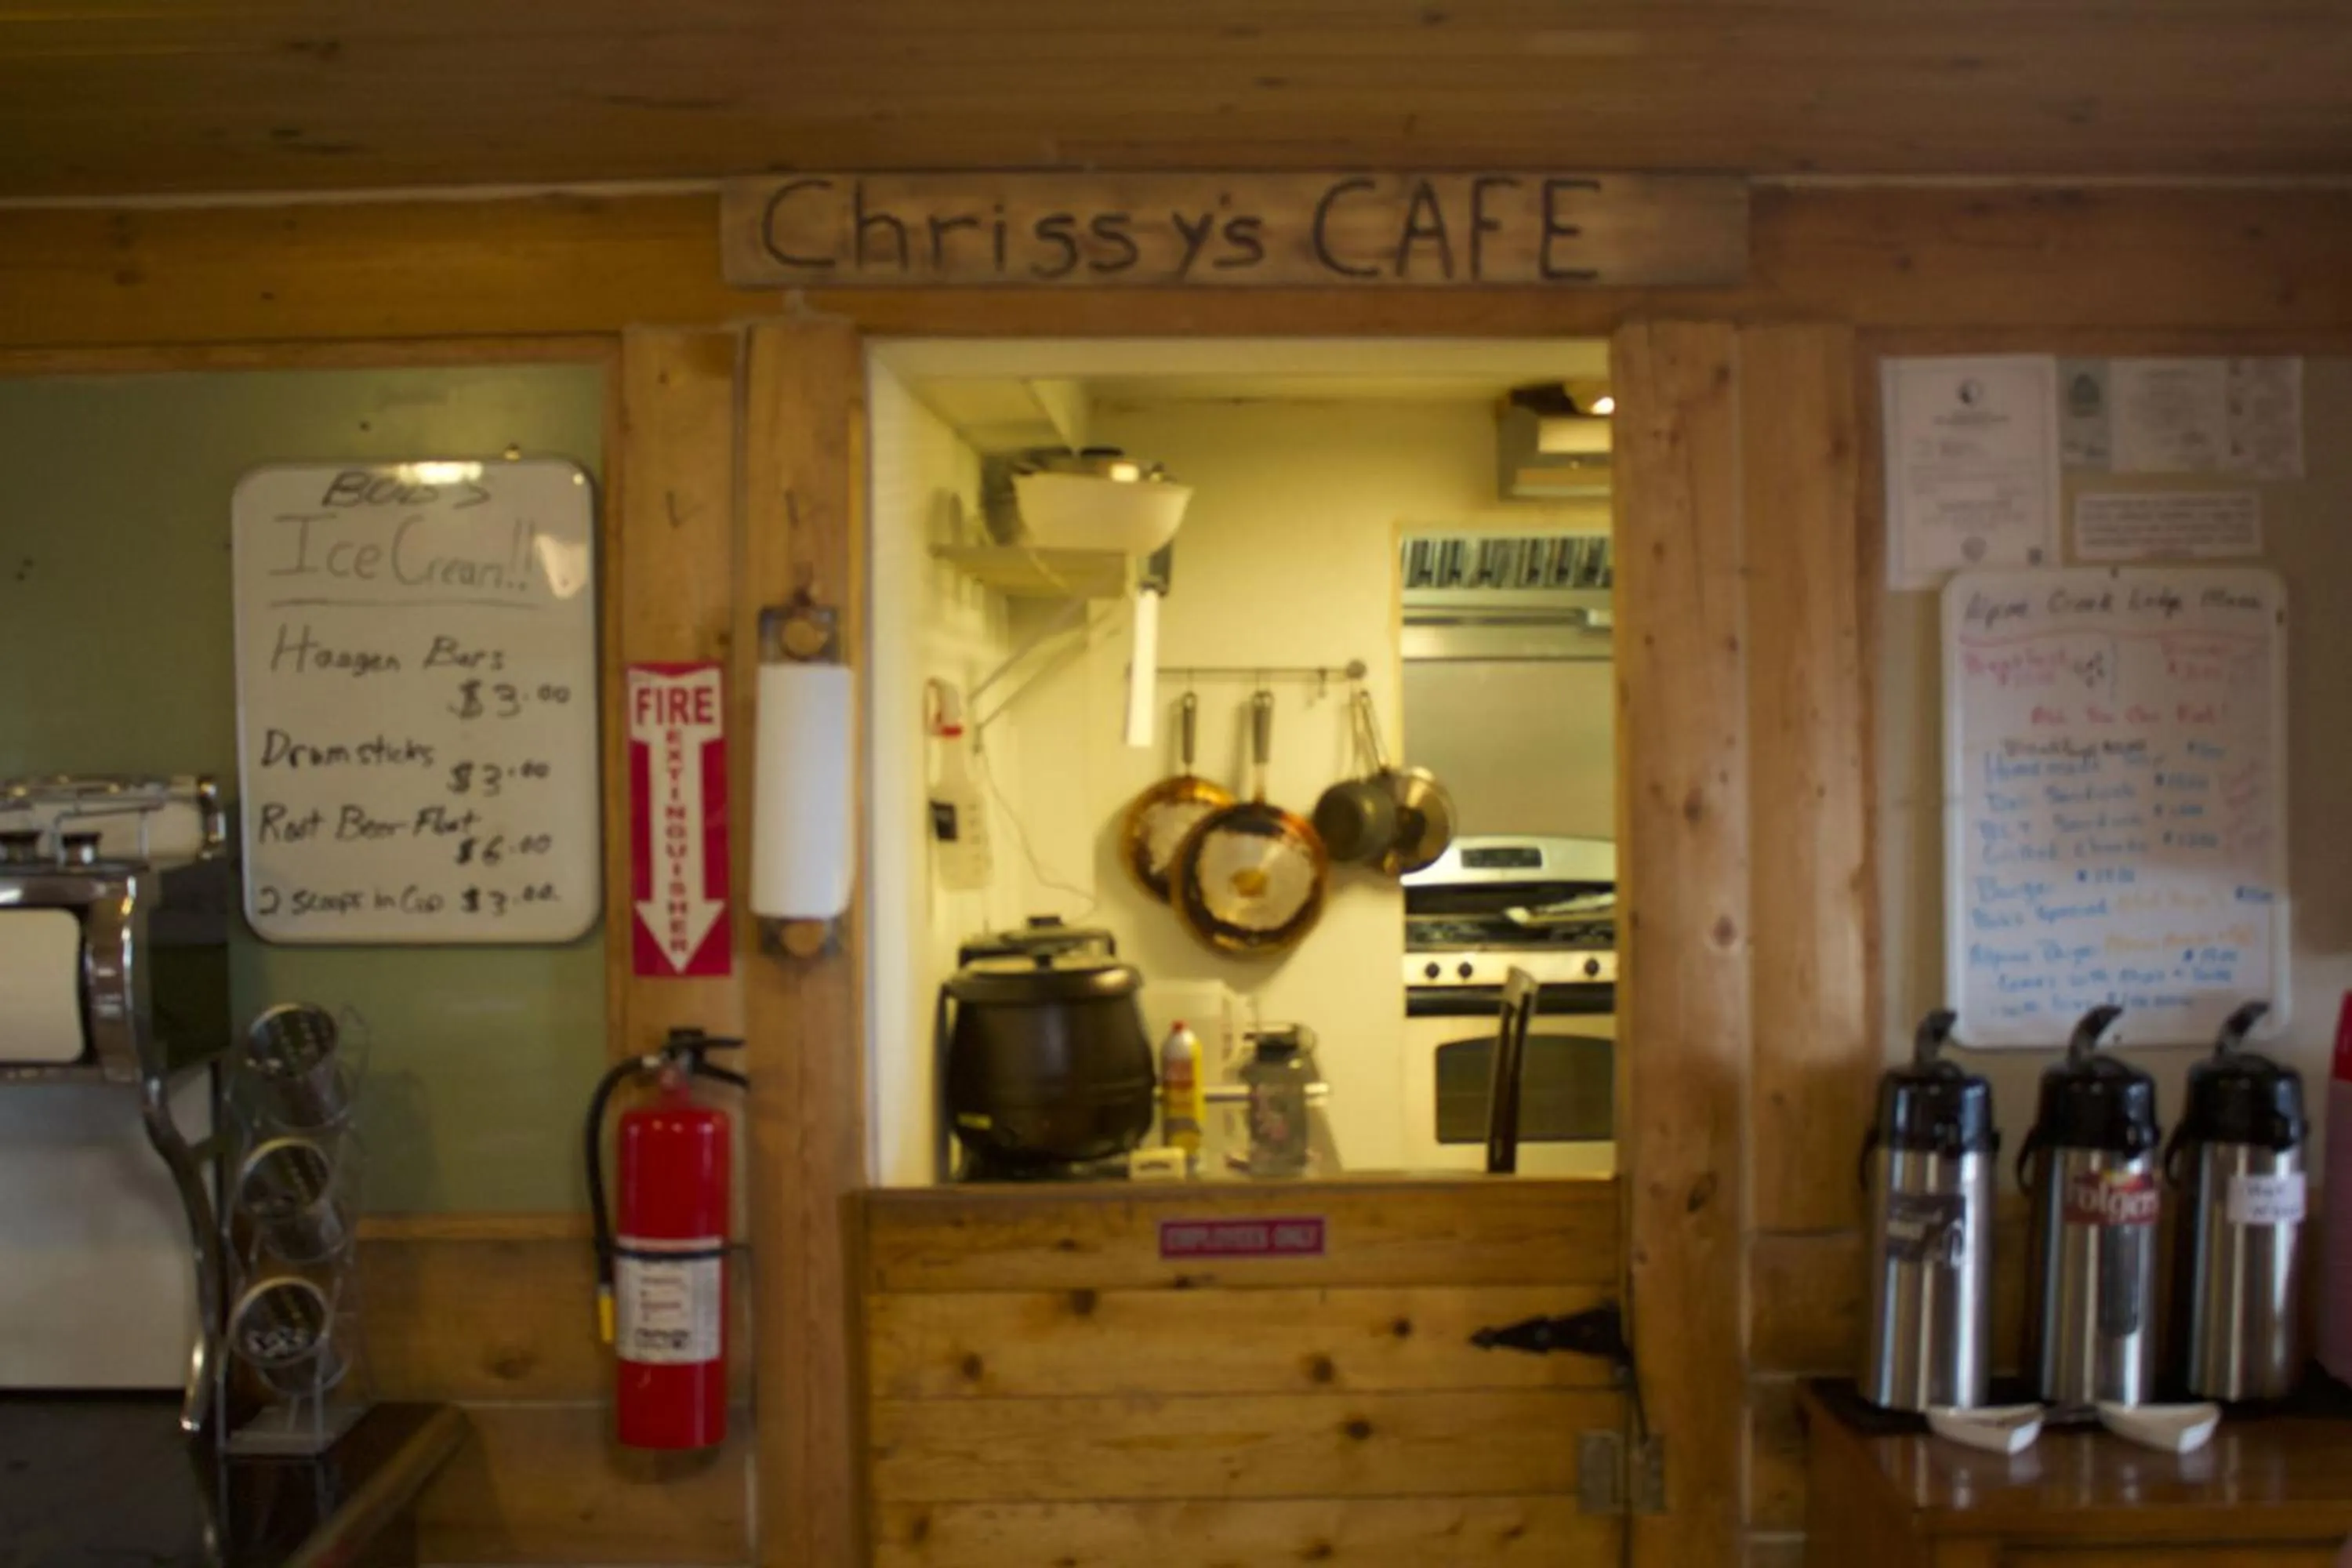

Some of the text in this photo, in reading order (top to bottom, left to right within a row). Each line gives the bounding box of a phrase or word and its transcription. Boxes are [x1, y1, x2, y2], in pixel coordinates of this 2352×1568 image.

[760, 174, 1604, 282] Chrissy's CAFE
[268, 513, 383, 579] Ice
[423, 634, 506, 670] Bars
[448, 679, 571, 720] $3.00
[635, 686, 714, 725] FIRE
[447, 760, 550, 797] $3.00
[258, 802, 324, 844] Root
[335, 804, 406, 841] Beer
[666, 729, 688, 953] EXTINGUISHER
[454, 834, 553, 866] $6.00
